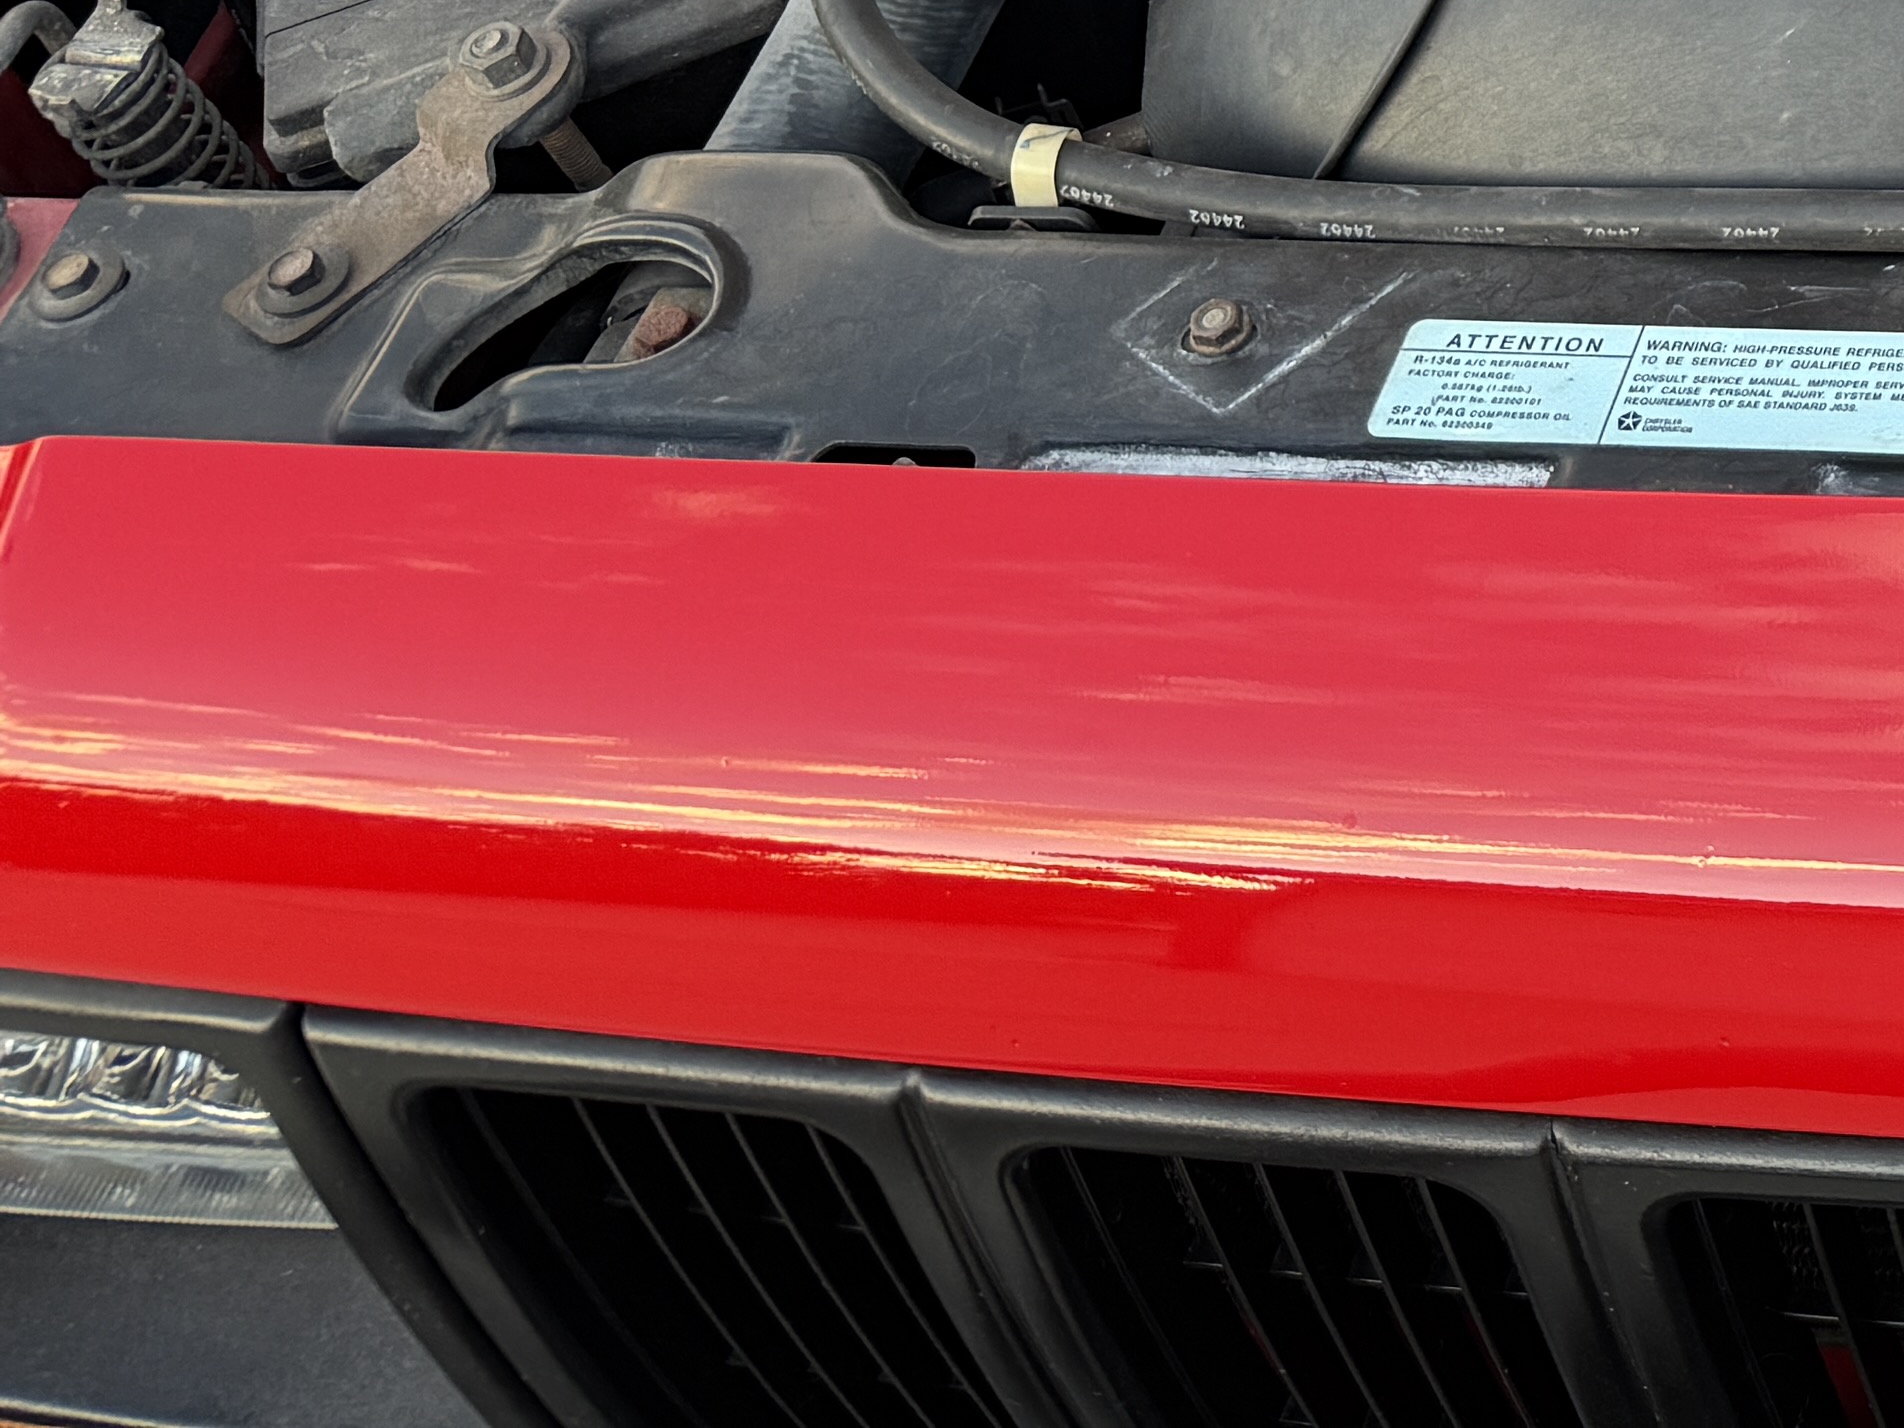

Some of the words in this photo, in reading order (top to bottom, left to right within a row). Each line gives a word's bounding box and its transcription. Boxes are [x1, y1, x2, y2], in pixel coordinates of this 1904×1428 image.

[1188, 209, 1244, 228] 24462
[1445, 333, 1604, 352] ATTENTION
[1646, 339, 1727, 354] WARNING:
[1732, 343, 1841, 357] HIGH-PRESSURE
[1413, 354, 1460, 366] R-134a
[1464, 358, 1486, 366] A/C
[1490, 359, 1570, 369] REFRIGERANT
[1641, 354, 1658, 365] TO
[1665, 355, 1683, 366] BE
[1690, 356, 1757, 368] SERVICED
[1764, 358, 1783, 369] BY
[1789, 359, 1861, 371] QUALIFIED
[1407, 368, 1459, 378] FACTORY
[1463, 370, 1515, 379] CHARGE:
[1632, 373, 1688, 384] CONSULT
[1693, 375, 1743, 385] SERVICE
[1807, 378, 1869, 389] IMPROPER
[1436, 394, 1466, 403] PART
[1628, 385, 1653, 394] MAY
[1660, 386, 1702, 396] CAUSE
[1709, 387, 1773, 398] PERSONAL
[1781, 389, 1825, 400] INJURY.
[1834, 391, 1882, 401] SYSTEM
[1623, 396, 1715, 408] REQUIREMENTS
[1718, 399, 1734, 408] OF
[1737, 400, 1760, 409] SAE
[1763, 400, 1827, 411] STANDARD
[1391, 405, 1411, 415] SP
[1416, 406, 1431, 416] 20
[1436, 406, 1465, 417] PAG
[1469, 409, 1549, 420] COMPRESSOR
[1553, 412, 1571, 421] OIL
[1386, 418, 1416, 427] PART
